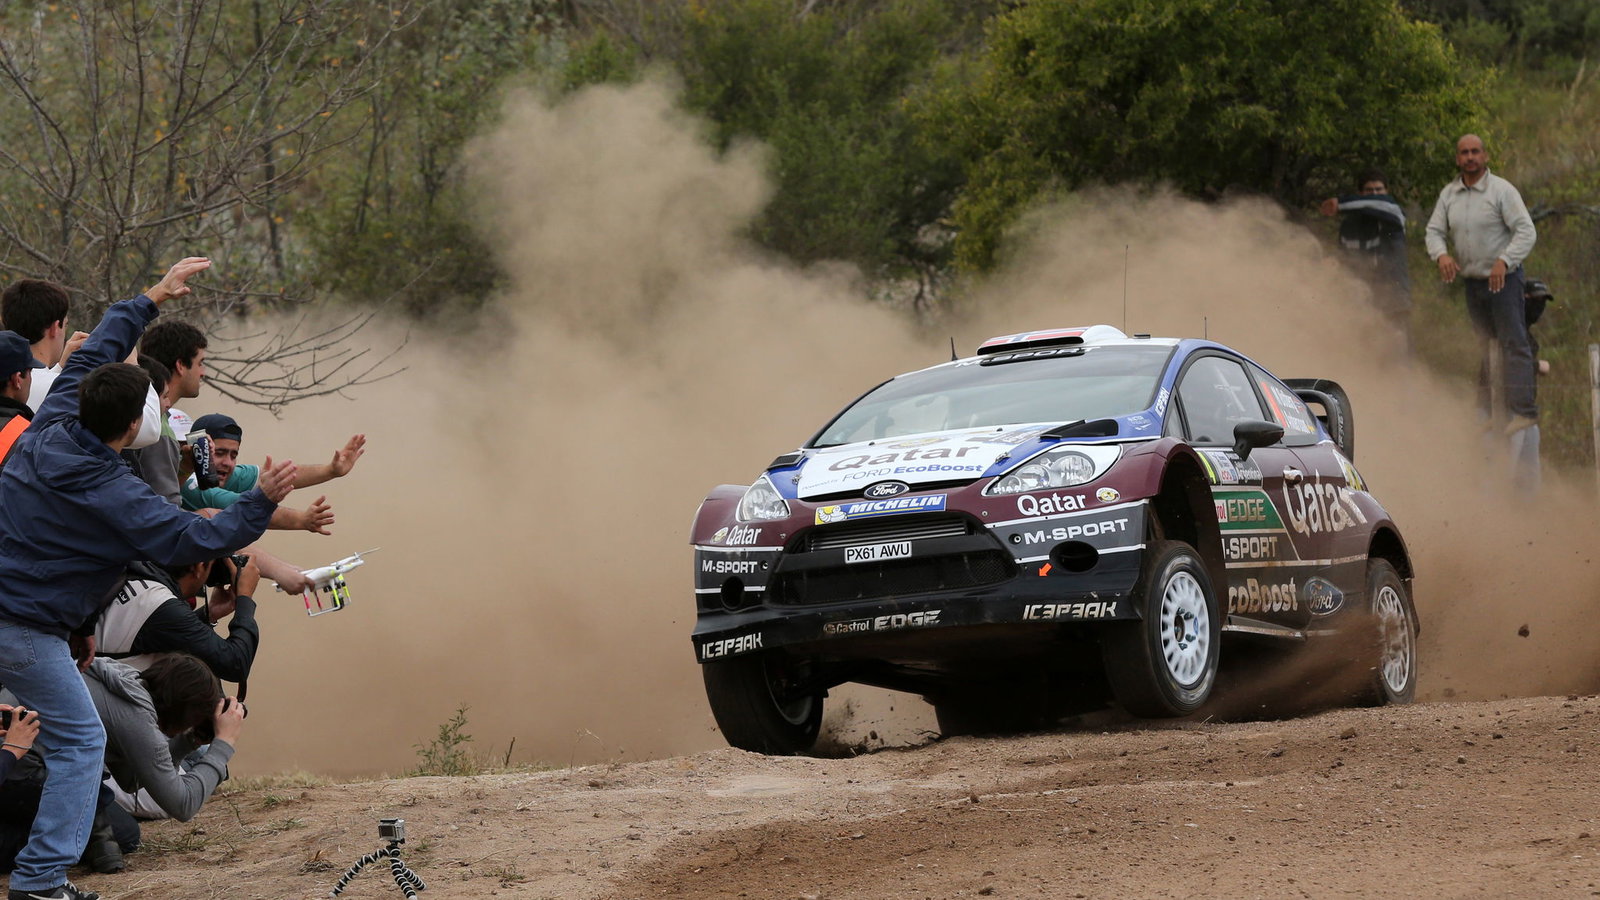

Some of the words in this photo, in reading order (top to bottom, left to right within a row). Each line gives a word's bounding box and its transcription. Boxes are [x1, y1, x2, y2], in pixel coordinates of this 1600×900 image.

[828, 446, 979, 472] Qatar
[842, 467, 891, 482] FORD
[893, 464, 983, 475] EcoBoost
[872, 484, 898, 496] Ford
[849, 495, 943, 514] MICHELIN
[1017, 492, 1086, 516] Qatar
[1228, 498, 1266, 522] EDGE
[1283, 467, 1368, 538] Qatar
[725, 525, 762, 546] Qatar
[1024, 518, 1128, 545] M-SPORT
[846, 547, 875, 561] PX61
[880, 543, 910, 558] AWU
[702, 559, 757, 574] M-SPORT
[836, 620, 870, 633] Castrol
[874, 609, 941, 631] EDGE
[1022, 602, 1117, 620] ICEPEAK
[702, 632, 763, 659] ICEPEAK
